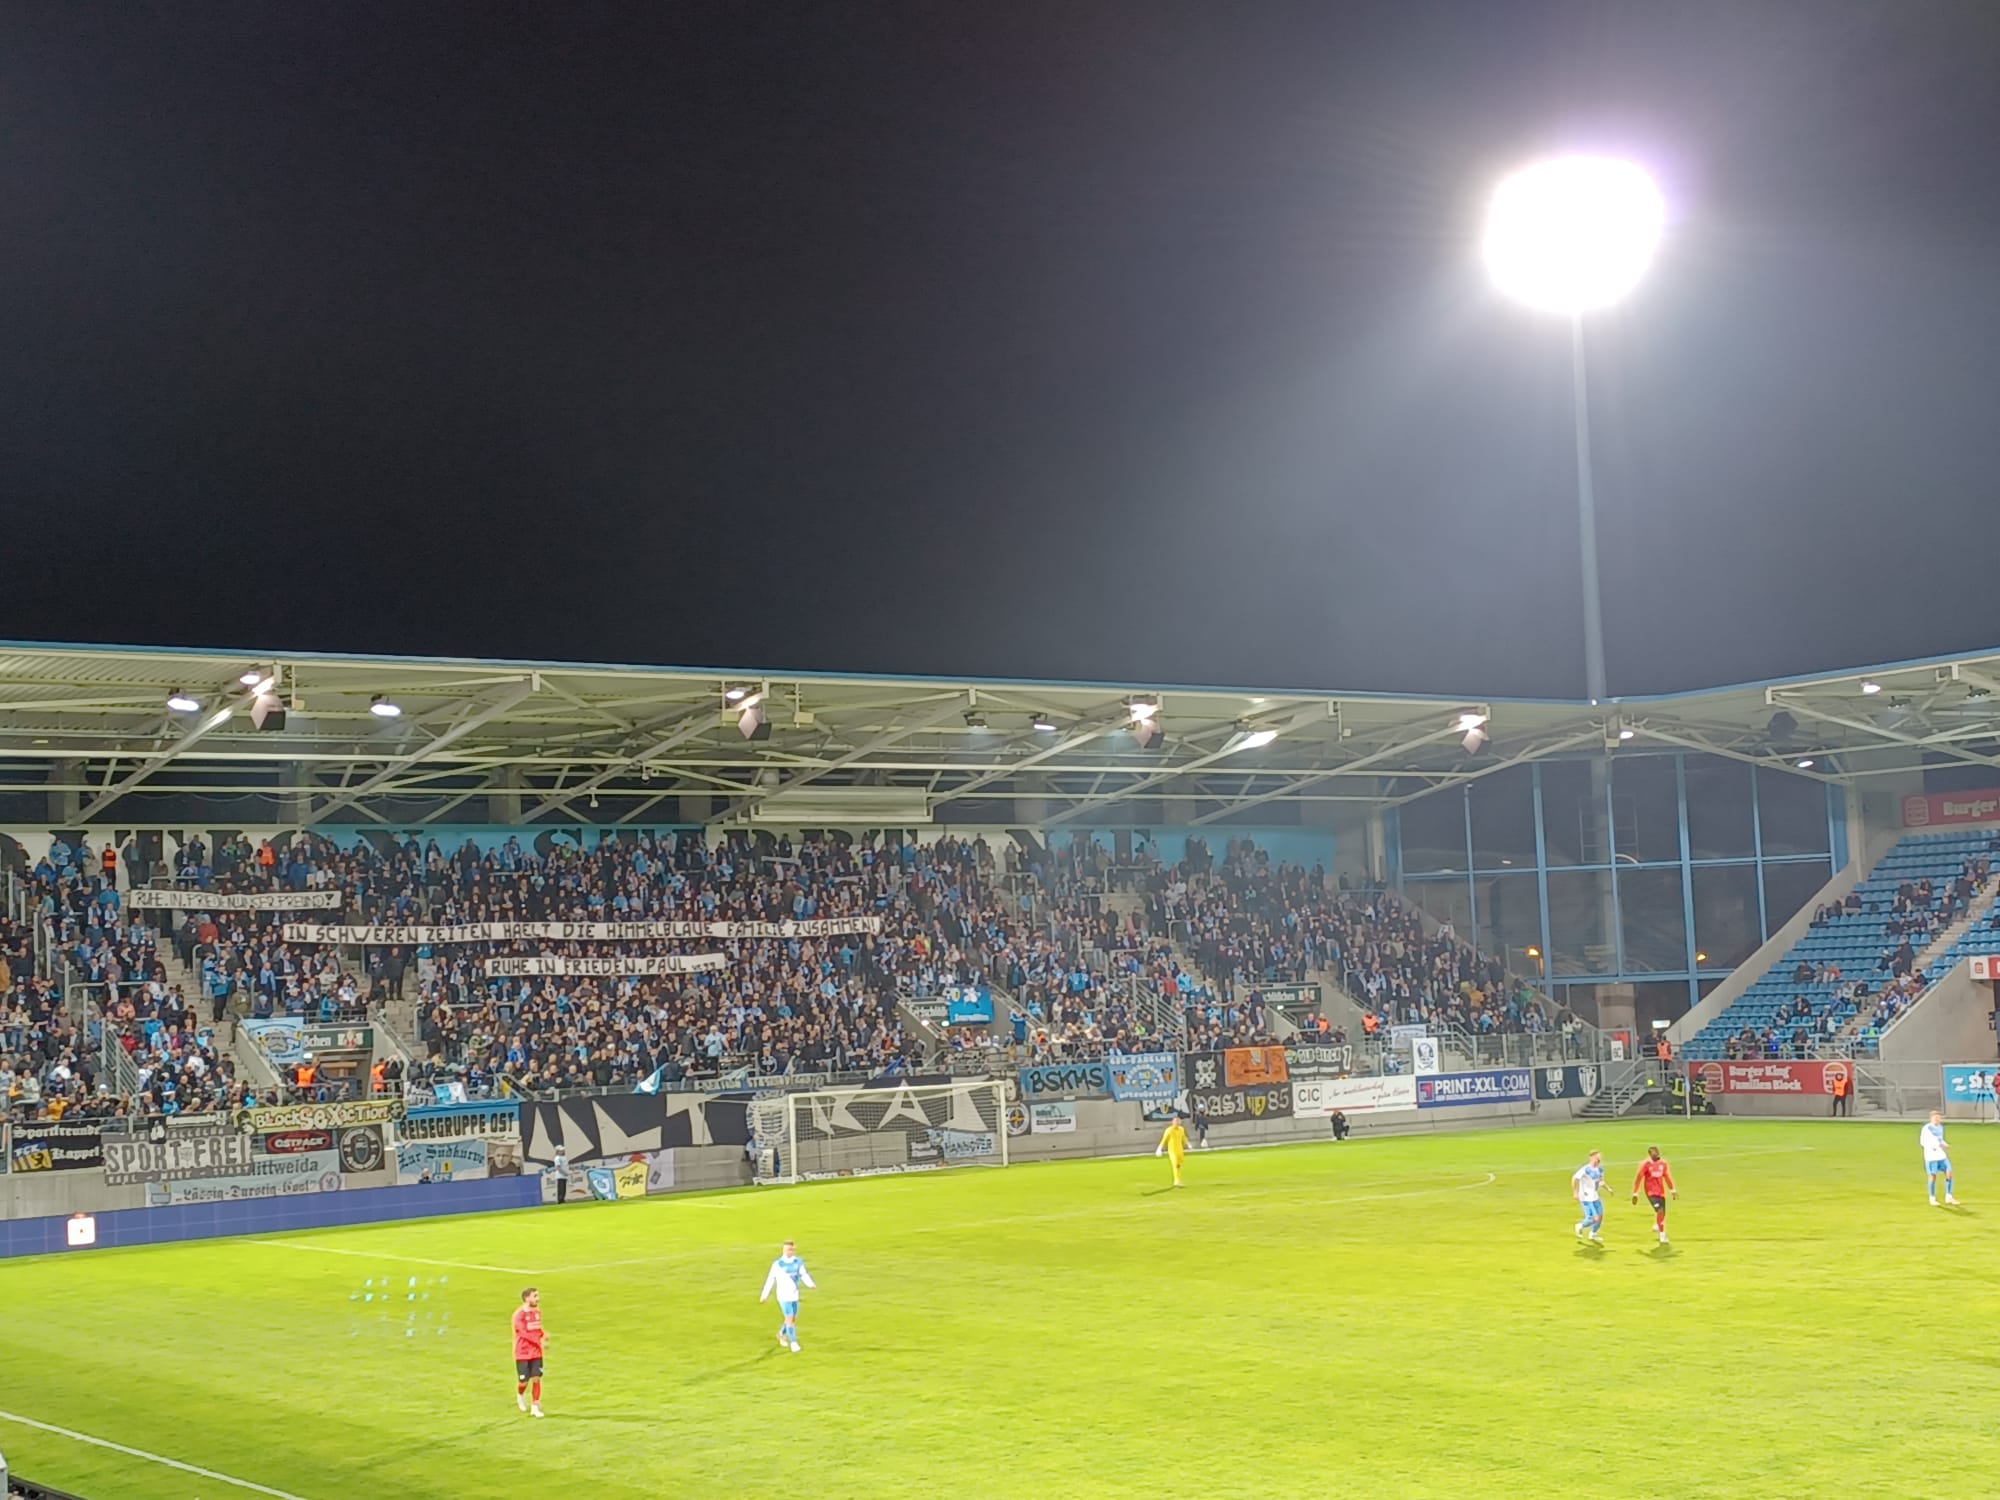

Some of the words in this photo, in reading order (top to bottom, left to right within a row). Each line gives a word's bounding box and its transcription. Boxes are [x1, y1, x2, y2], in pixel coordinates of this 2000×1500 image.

[287, 925, 308, 941] IN
[315, 926, 419, 942] SCHWEREN
[425, 924, 492, 942] ZEITEN
[503, 923, 549, 938] HAELT
[563, 924, 595, 938] DIE
[606, 922, 713, 938] HIMMELBLAUE
[727, 922, 786, 936] FAMILIE
[490, 959, 531, 974] RUHE
[536, 959, 556, 974] IN
[646, 958, 687, 973] PAUL
[1030, 1067, 1105, 1093] BSKMS
[1729, 1066, 1764, 1080] Burger
[1765, 1065, 1792, 1079] King
[1434, 1074, 1530, 1095] PRINT-XXL.COM
[1730, 1079, 1772, 1090] Familien
[1773, 1079, 1802, 1090] Block
[1267, 1088, 1290, 1111] 85
[1298, 1088, 1320, 1102] CIC
[399, 1113, 486, 1140] REISEGRUPPE
[490, 1111, 515, 1133] OST
[107, 1140, 181, 1172] SPORT
[193, 1136, 247, 1166] FREI
